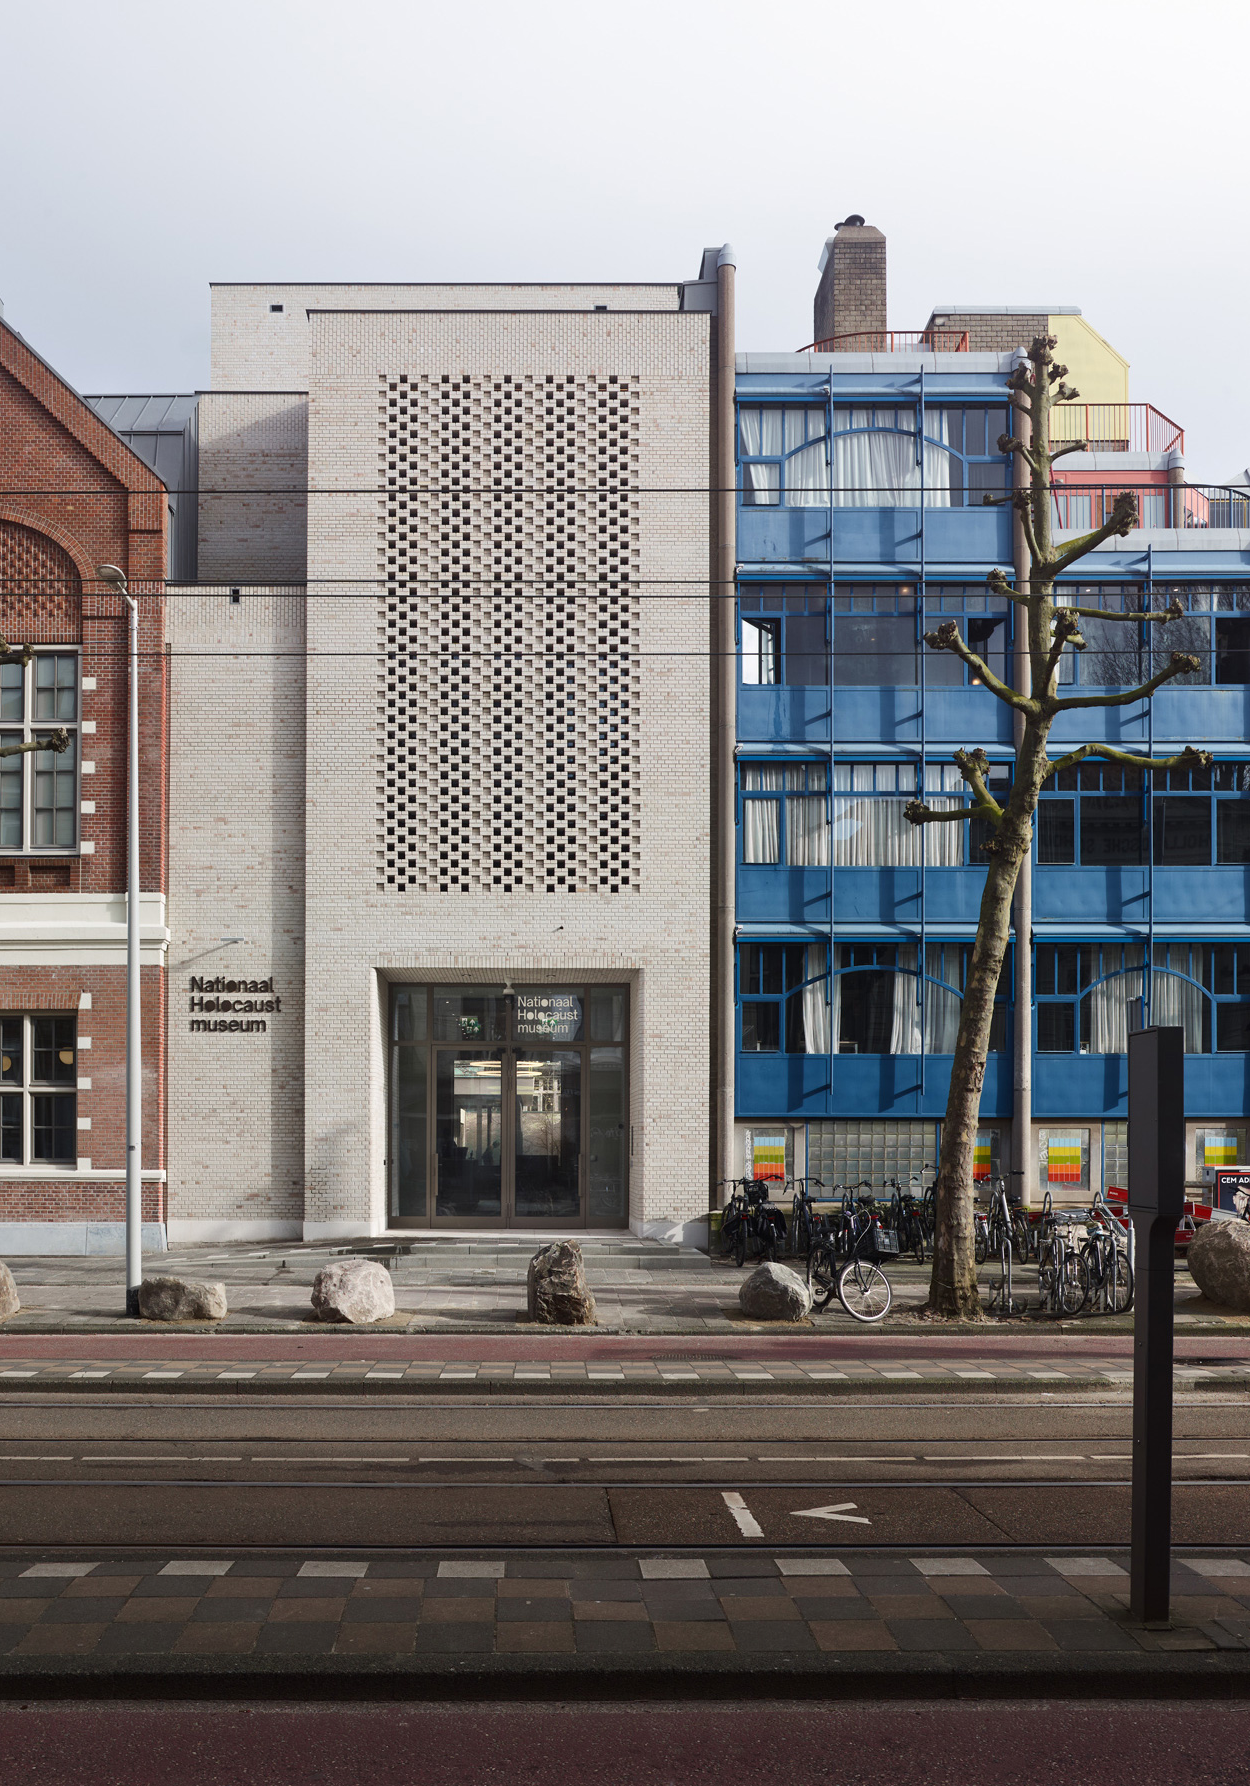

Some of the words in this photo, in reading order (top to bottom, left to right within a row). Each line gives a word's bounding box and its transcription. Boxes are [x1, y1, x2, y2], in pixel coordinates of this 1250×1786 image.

[190, 975, 275, 993] Nationaal
[190, 995, 282, 1013] Holocaust
[517, 996, 573, 1008] Nationaal
[517, 1009, 579, 1021] Holocaust
[190, 1018, 267, 1032] museum
[517, 1024, 569, 1034] museum
[1221, 1176, 1237, 1184] CEM
